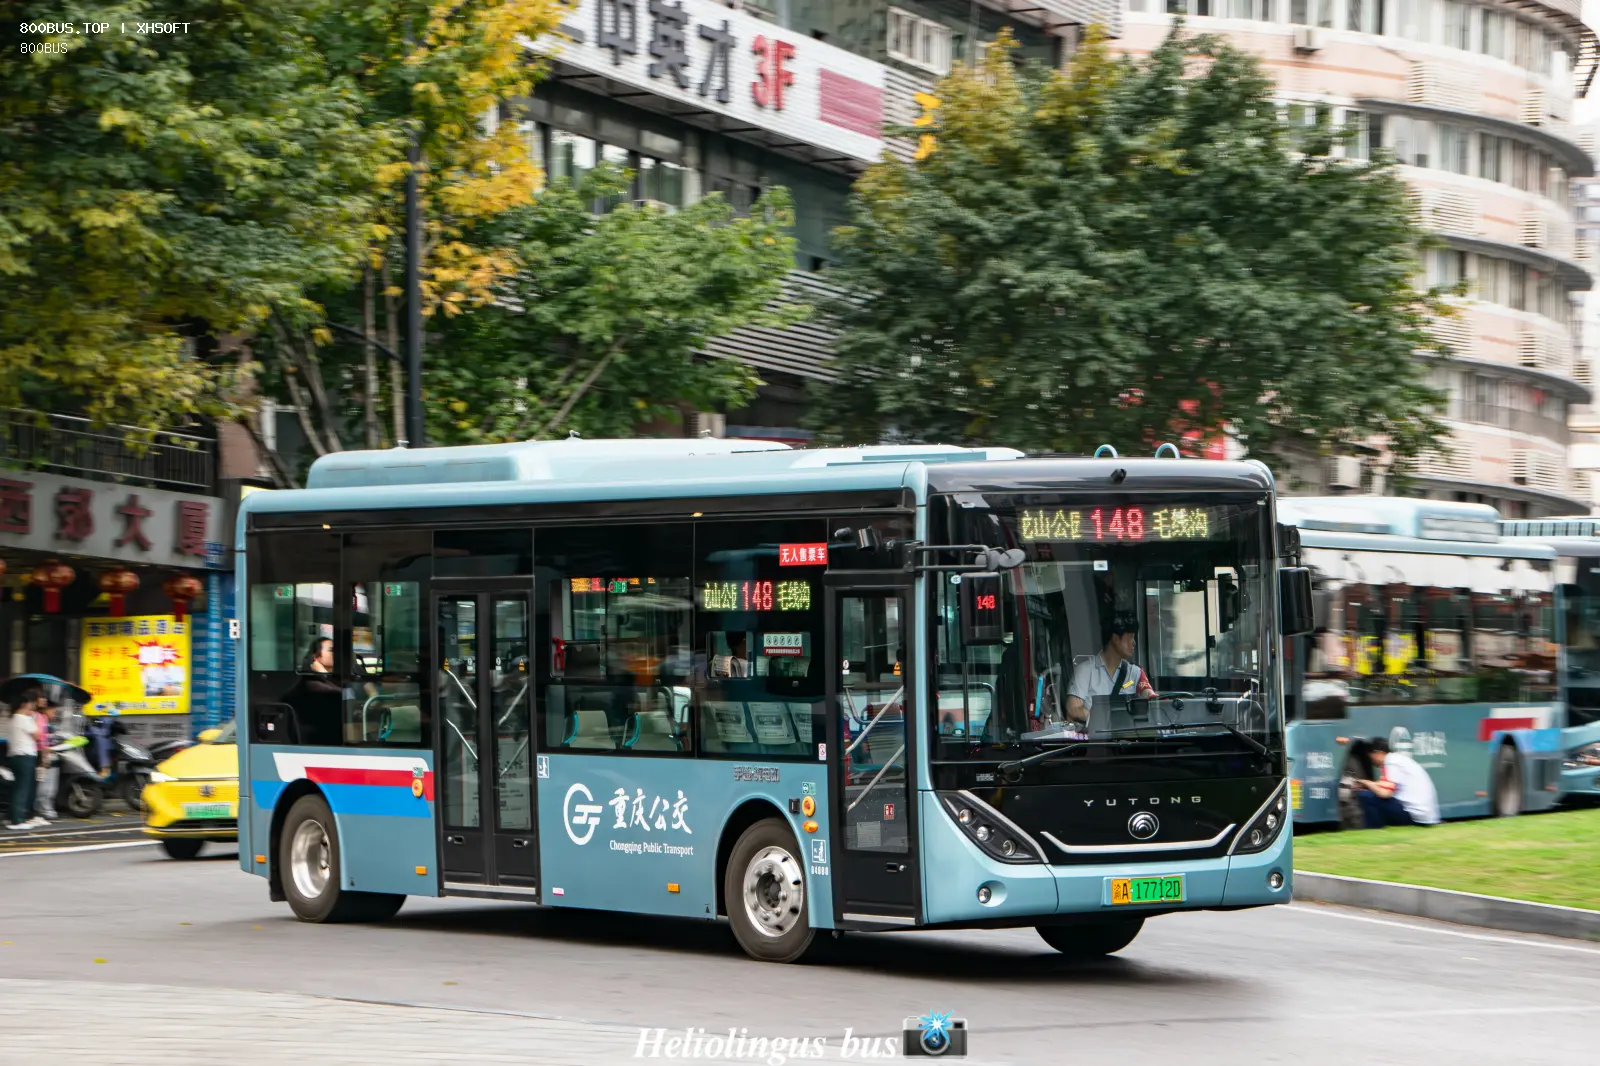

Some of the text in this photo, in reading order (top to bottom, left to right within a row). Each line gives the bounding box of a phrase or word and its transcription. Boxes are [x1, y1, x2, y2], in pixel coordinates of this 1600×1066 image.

[752, 34, 796, 110] 3F
[1091, 509, 1143, 539] 148
[782, 548, 825, 563] 无人售票车
[742, 581, 773, 610] 148
[609, 788, 692, 834] 重庆公交
[1084, 796, 1201, 807] YUTONG
[609, 840, 694, 857] Chongqing Public Transport
